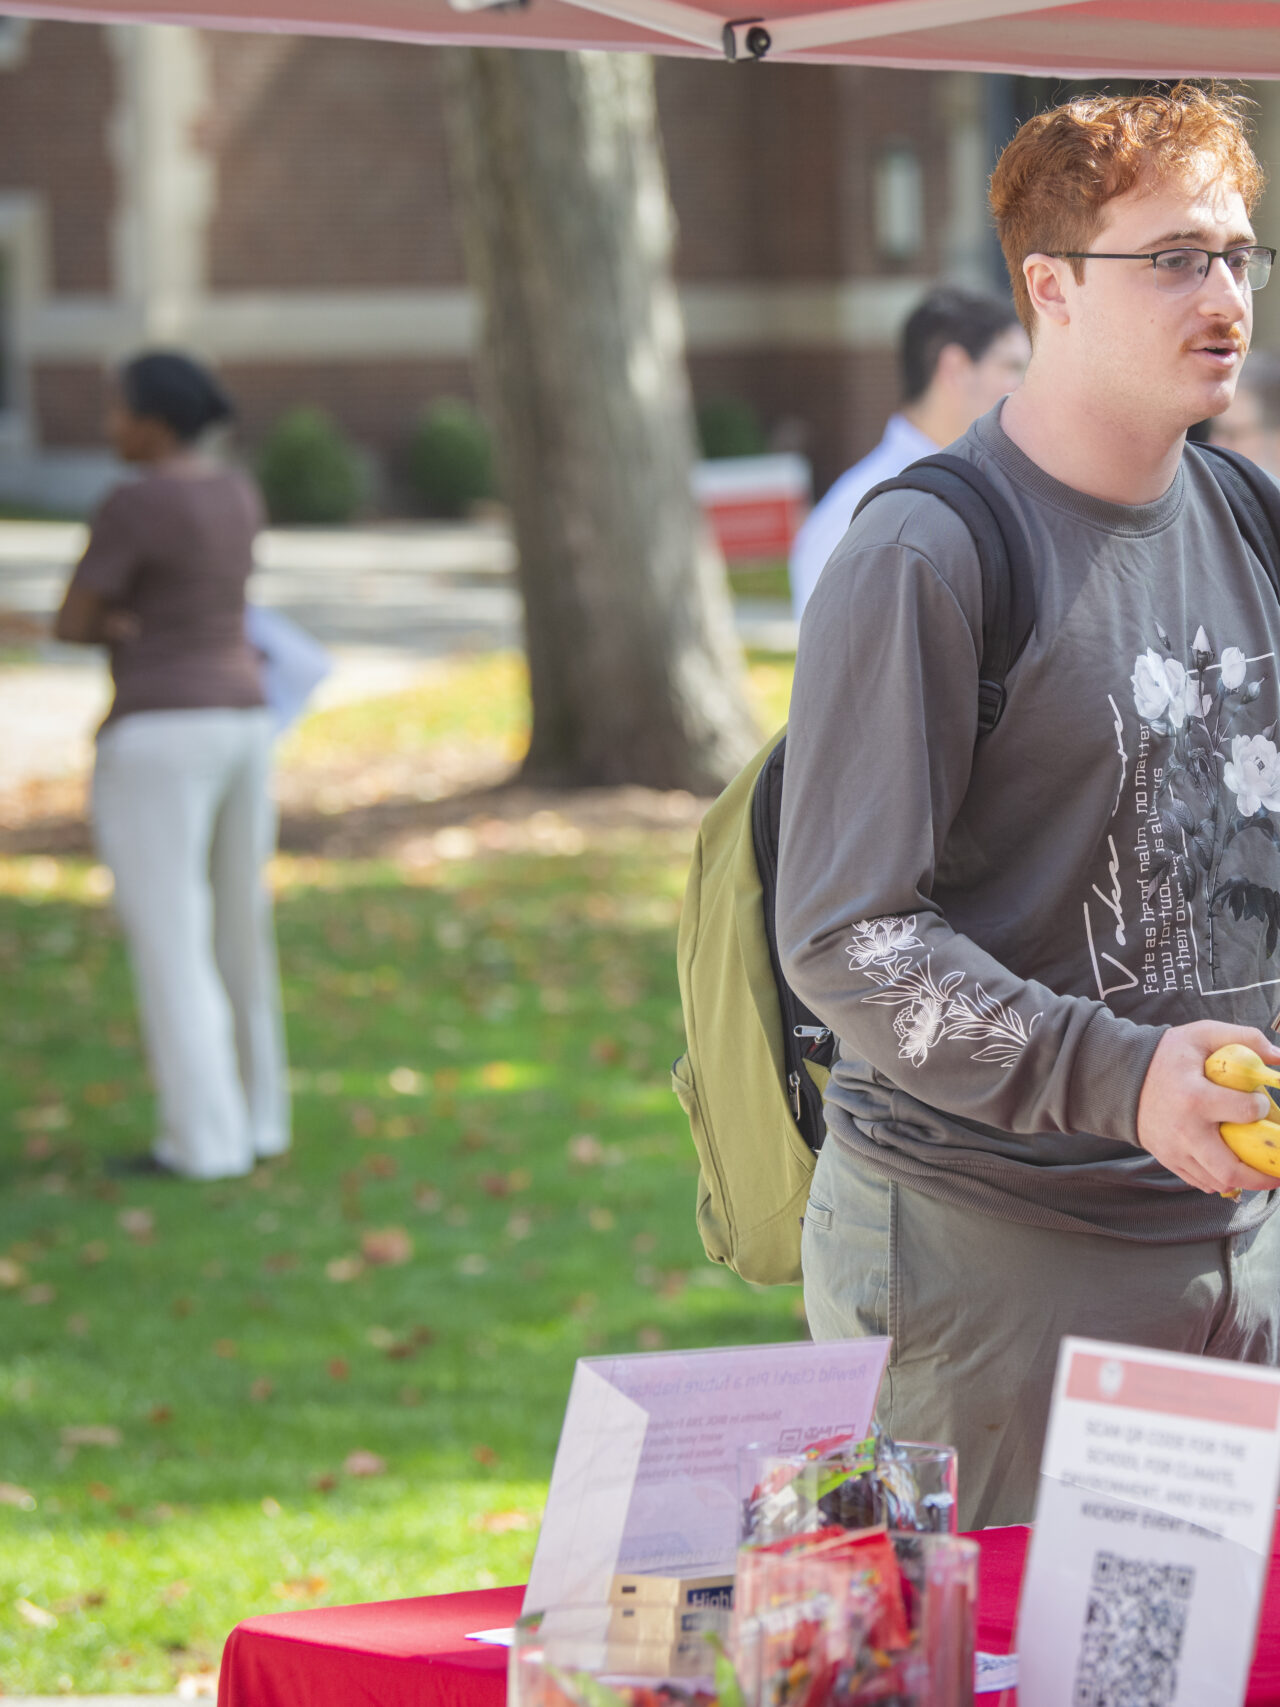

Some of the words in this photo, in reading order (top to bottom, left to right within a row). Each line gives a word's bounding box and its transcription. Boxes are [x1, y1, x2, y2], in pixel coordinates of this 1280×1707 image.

[1135, 723, 1150, 786] matter
[1135, 792, 1147, 813] no
[1153, 838, 1164, 851] is
[1083, 834, 1139, 999] Take
[1144, 927, 1156, 948] as
[1175, 927, 1191, 967] their
[1141, 952, 1158, 994] Fate
[1162, 952, 1176, 991] how
[1181, 974, 1192, 989] in
